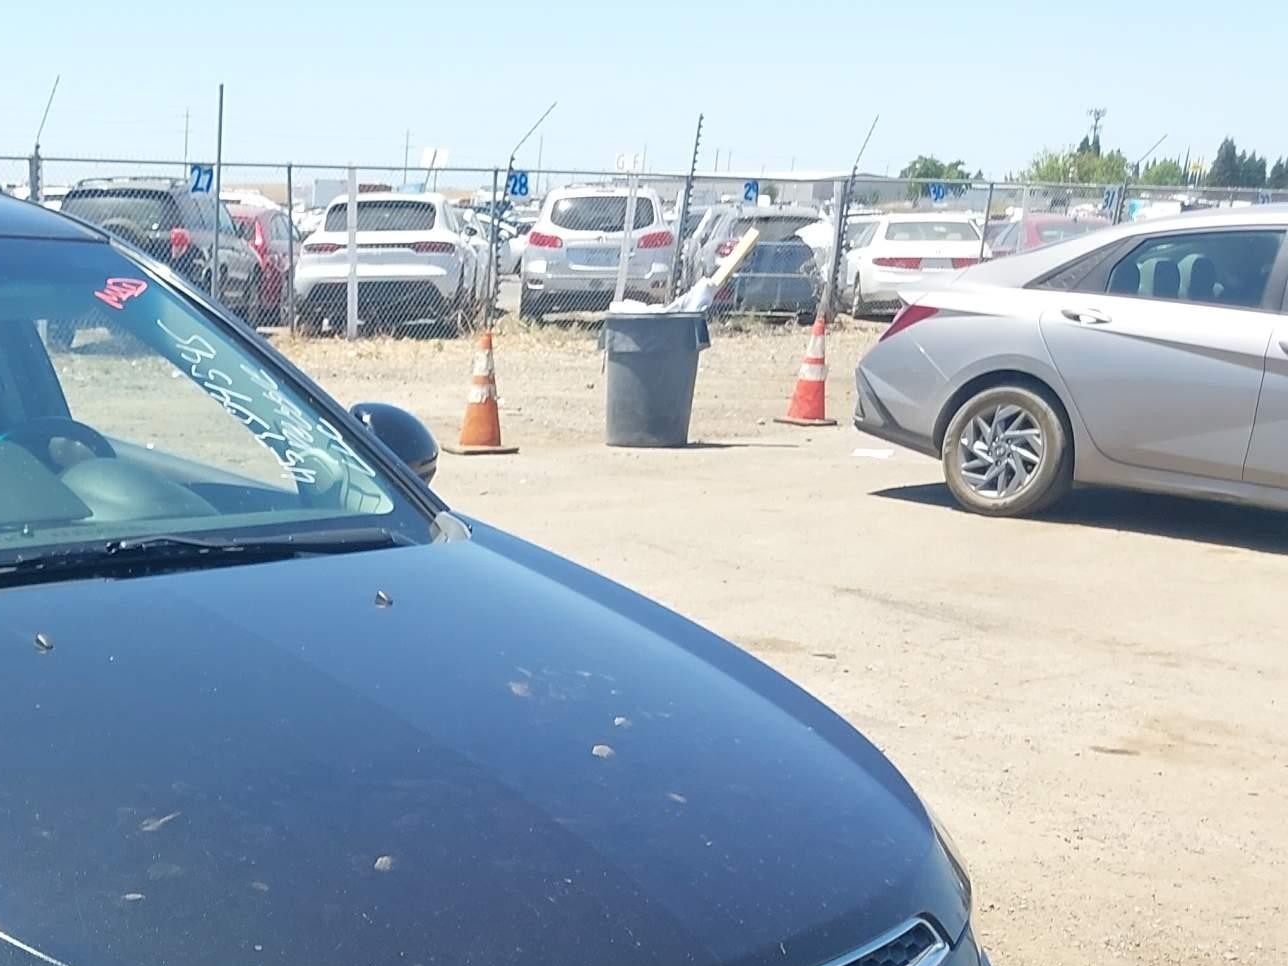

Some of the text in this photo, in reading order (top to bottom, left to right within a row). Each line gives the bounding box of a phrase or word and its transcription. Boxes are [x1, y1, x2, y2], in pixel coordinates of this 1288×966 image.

[189, 164, 214, 193] 27
[509, 172, 529, 196] 28
[743, 179, 759, 202] 29
